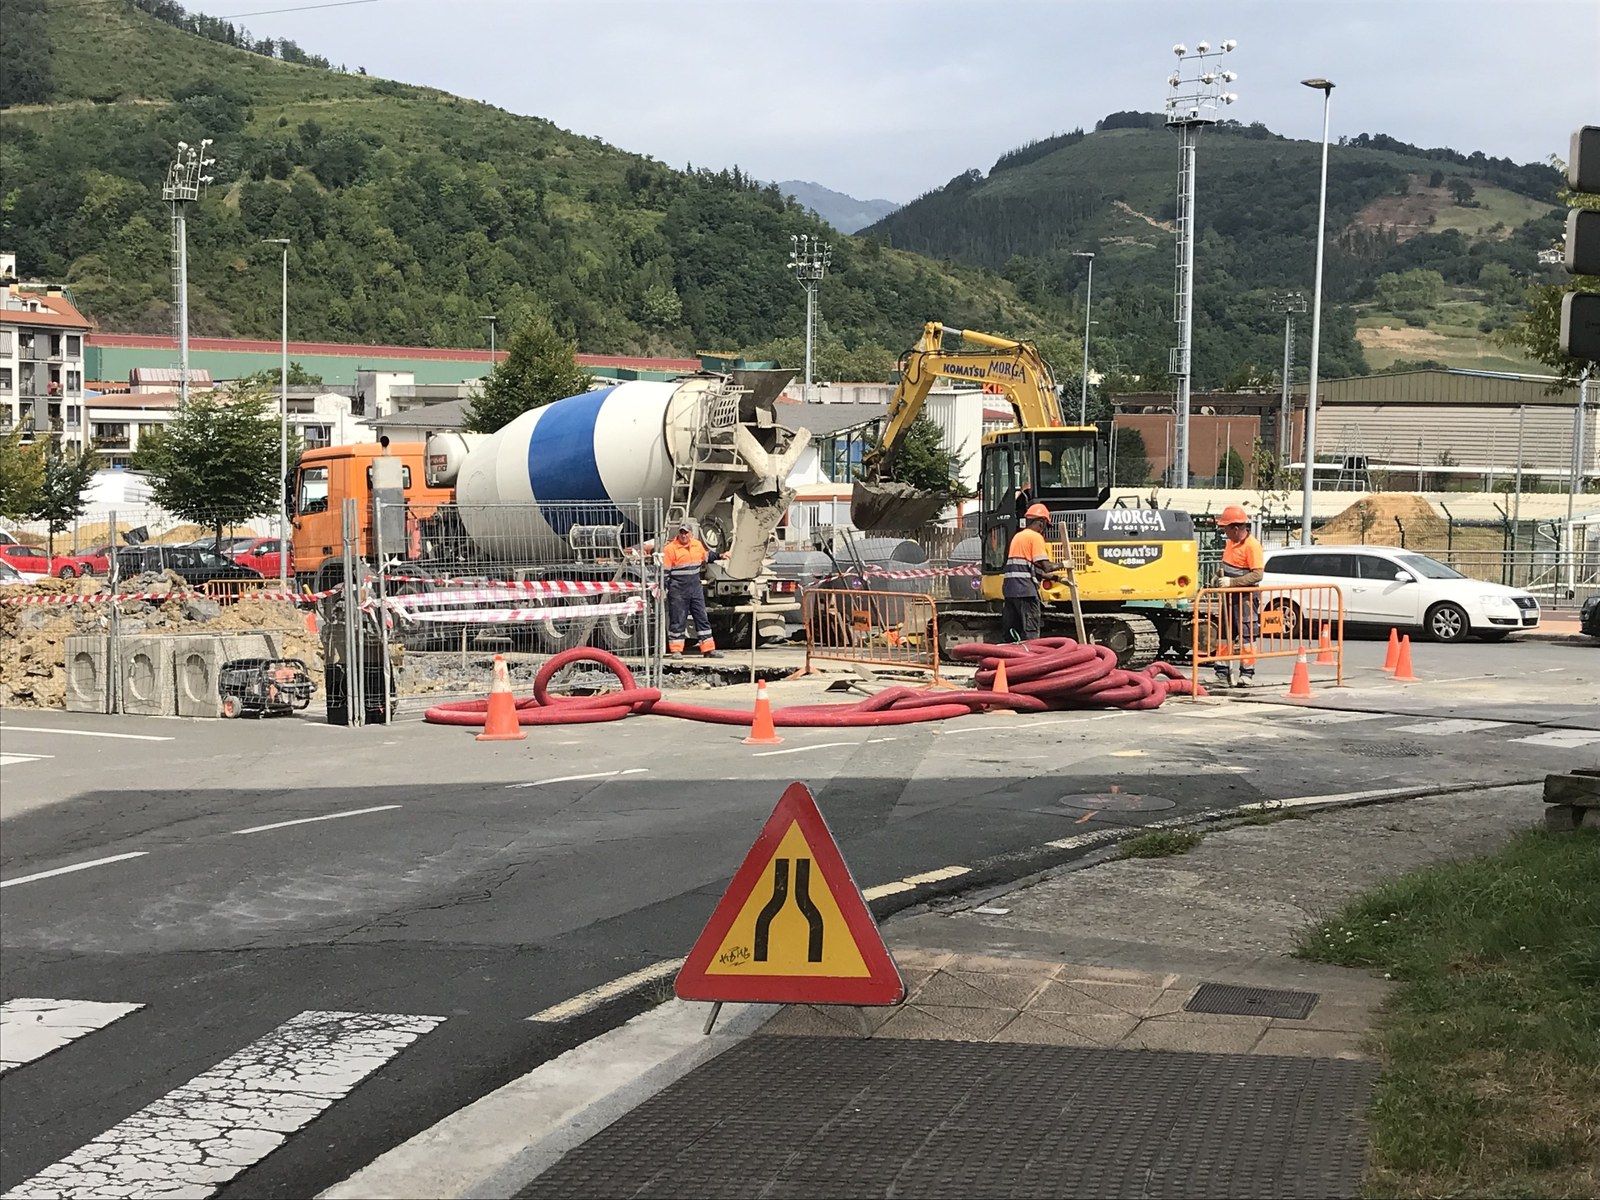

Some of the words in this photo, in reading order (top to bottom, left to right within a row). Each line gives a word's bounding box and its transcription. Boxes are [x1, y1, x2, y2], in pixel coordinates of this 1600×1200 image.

[943, 363, 985, 378] KOMATSU
[986, 360, 1026, 384] MORGA
[1103, 510, 1166, 531] MORGA
[1103, 545, 1158, 557] KOMATSU
